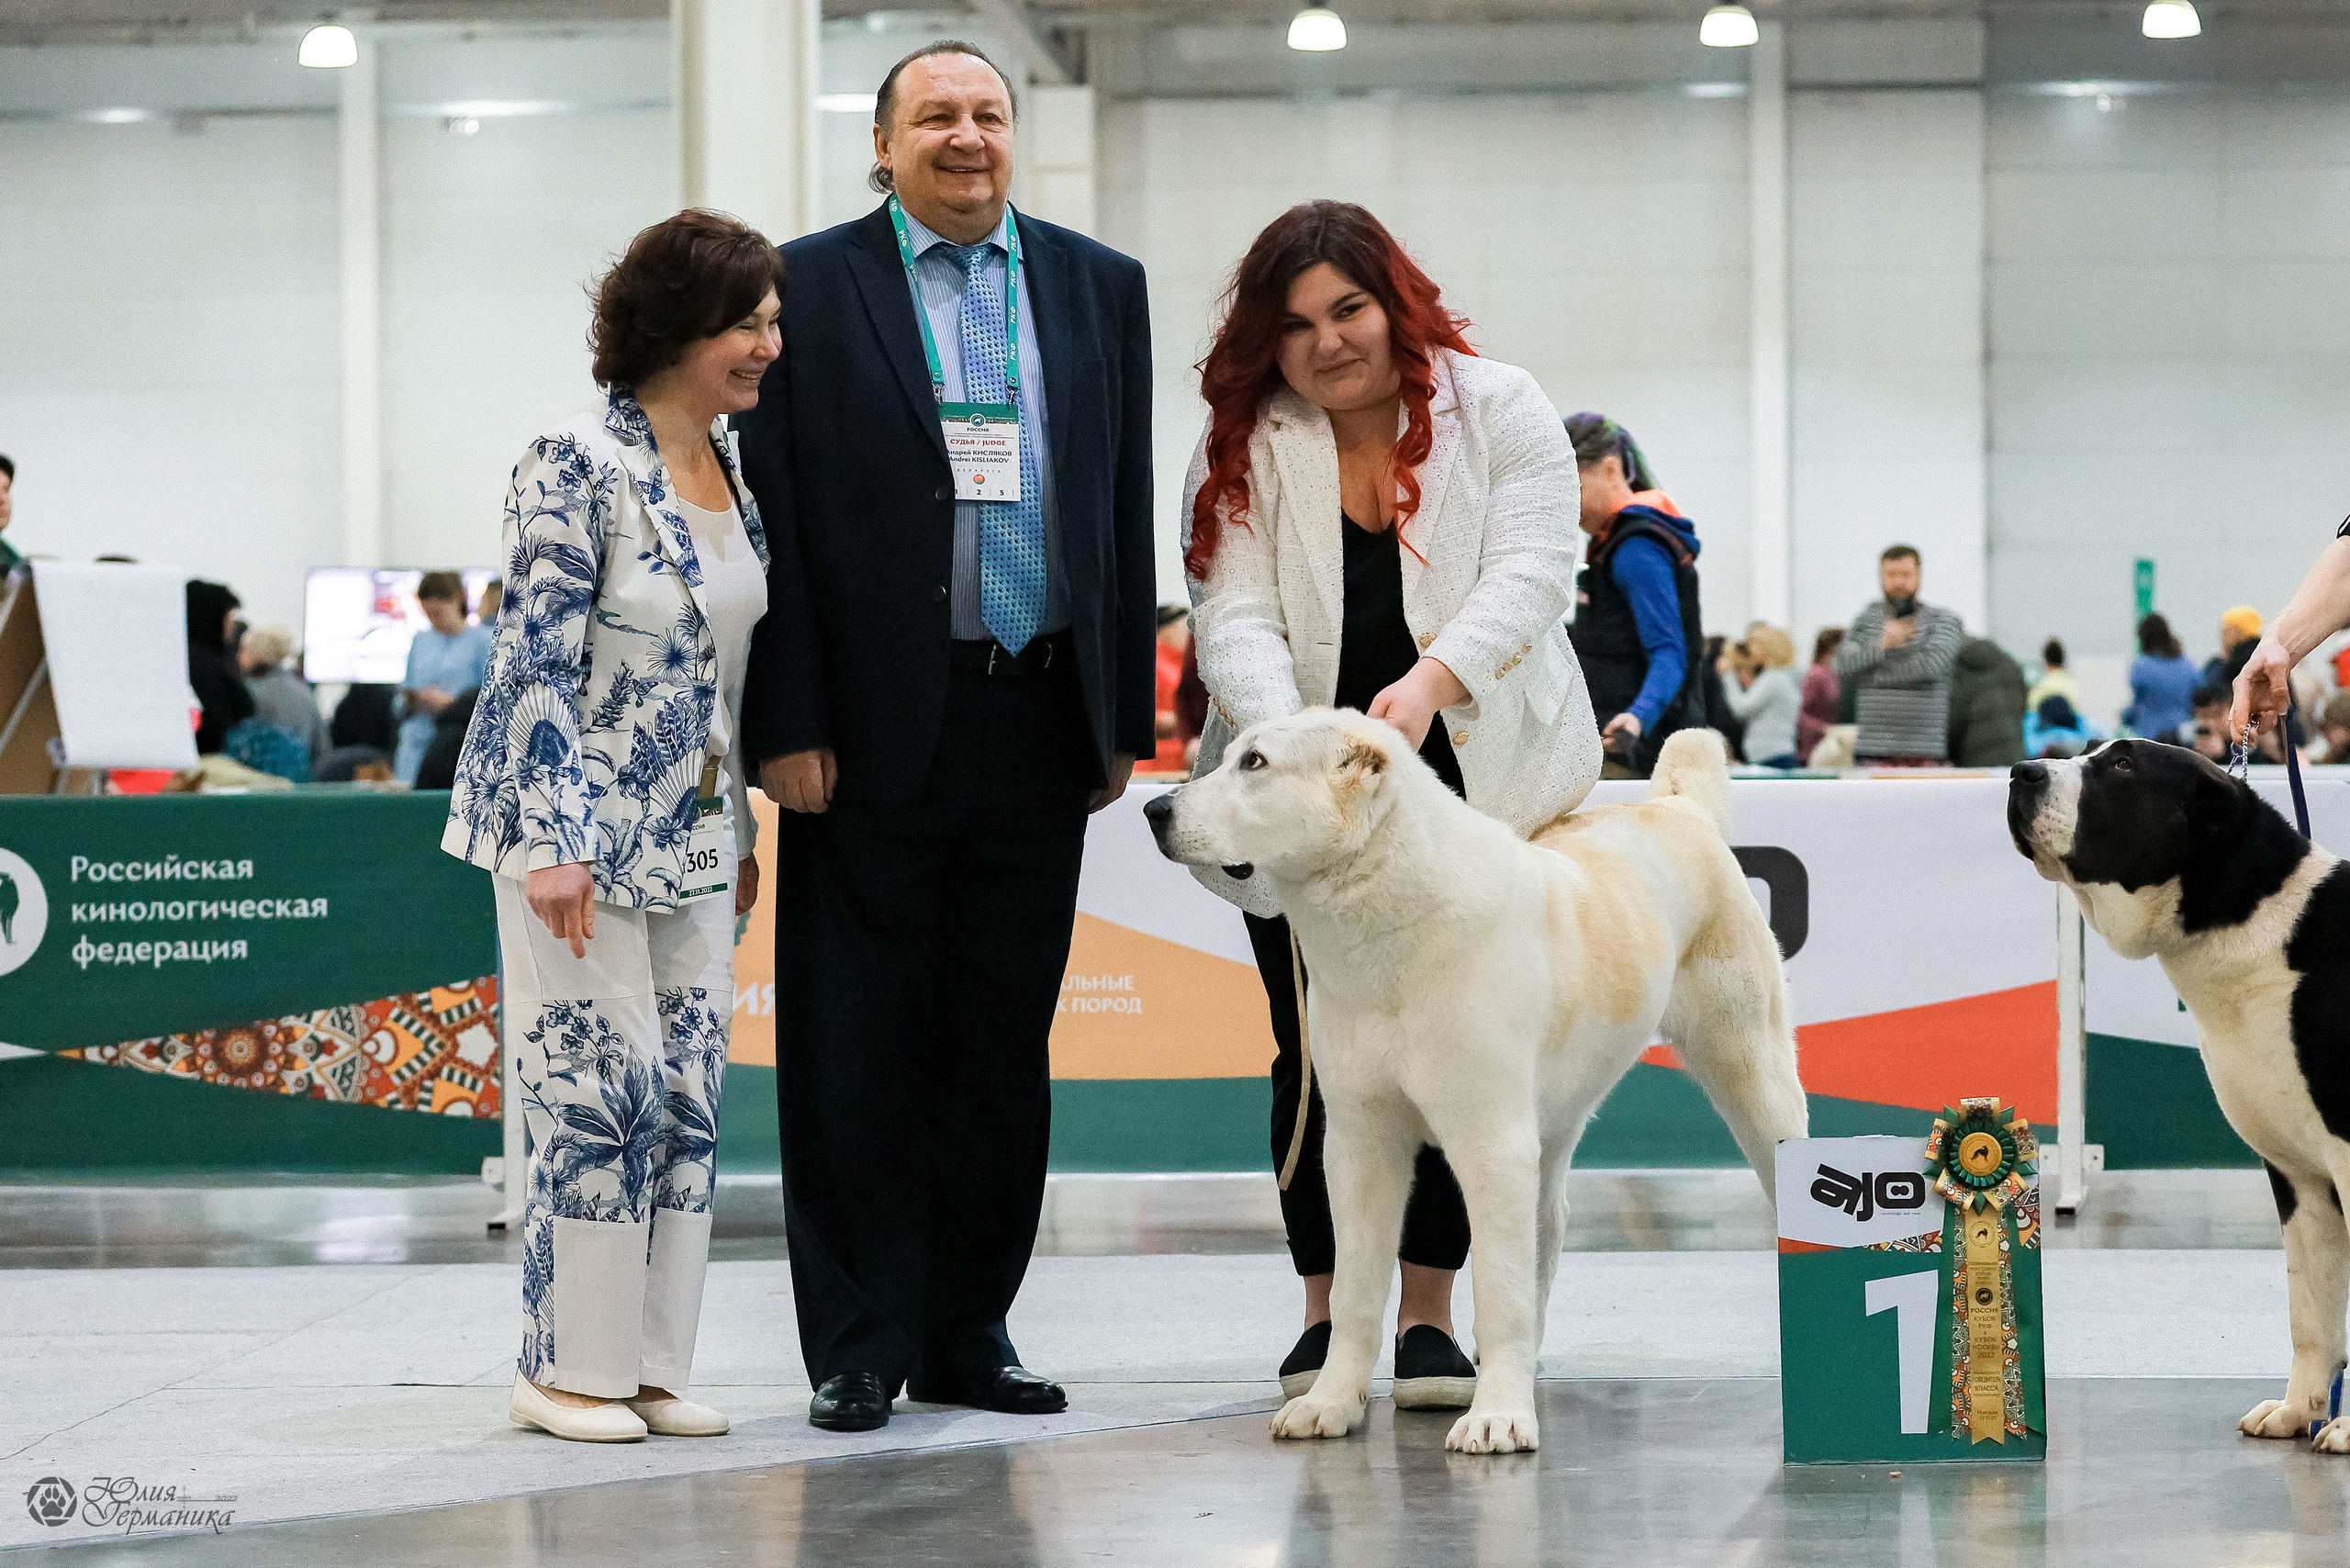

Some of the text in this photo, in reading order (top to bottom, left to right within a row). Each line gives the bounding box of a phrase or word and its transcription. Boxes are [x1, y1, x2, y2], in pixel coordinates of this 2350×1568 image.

[899, 229, 908, 247] РКФ
[949, 438, 975, 446] СУДЬЯ
[71, 855, 254, 882] Российская
[687, 848, 719, 873] 305
[688, 886, 713, 897] 27.11.2022
[71, 898, 329, 923] кинологическая
[71, 935, 249, 969] федерация
[1061, 975, 1134, 991] ЛЬНЫЕ
[1072, 997, 1143, 1014] ПОРОД
[1865, 1270, 1939, 1434] 1
